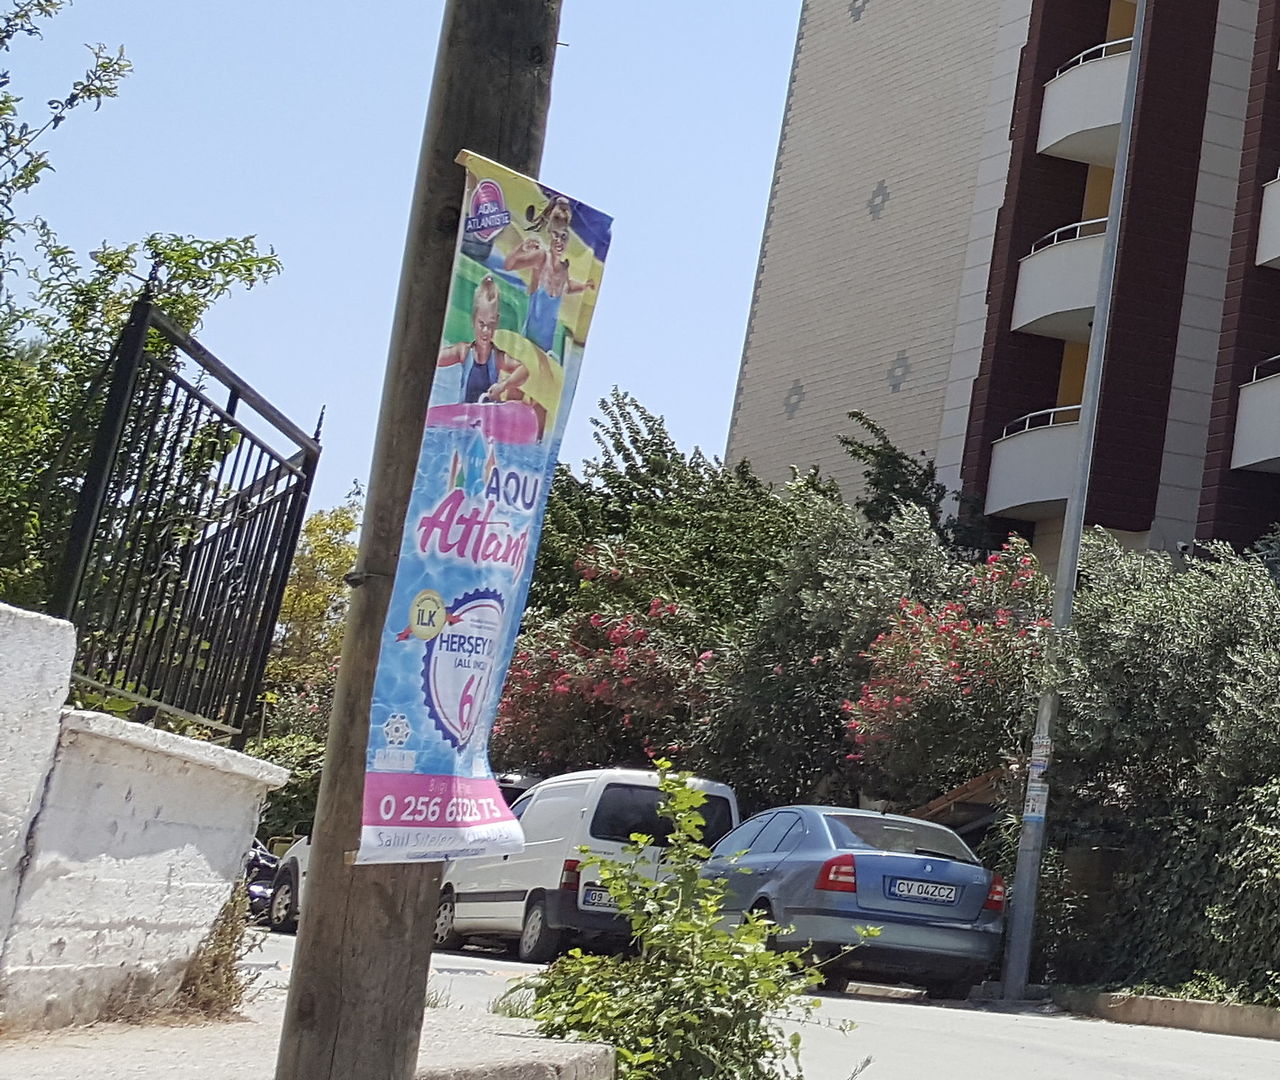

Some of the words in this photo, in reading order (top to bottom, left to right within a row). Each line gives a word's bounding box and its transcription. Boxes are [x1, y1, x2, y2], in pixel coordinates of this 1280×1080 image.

[439, 633, 488, 658] HERŞEY
[380, 794, 396, 821] 0
[401, 796, 442, 822] 256
[377, 831, 409, 847] Sahil
[897, 881, 914, 894] CV
[591, 892, 603, 902] 09
